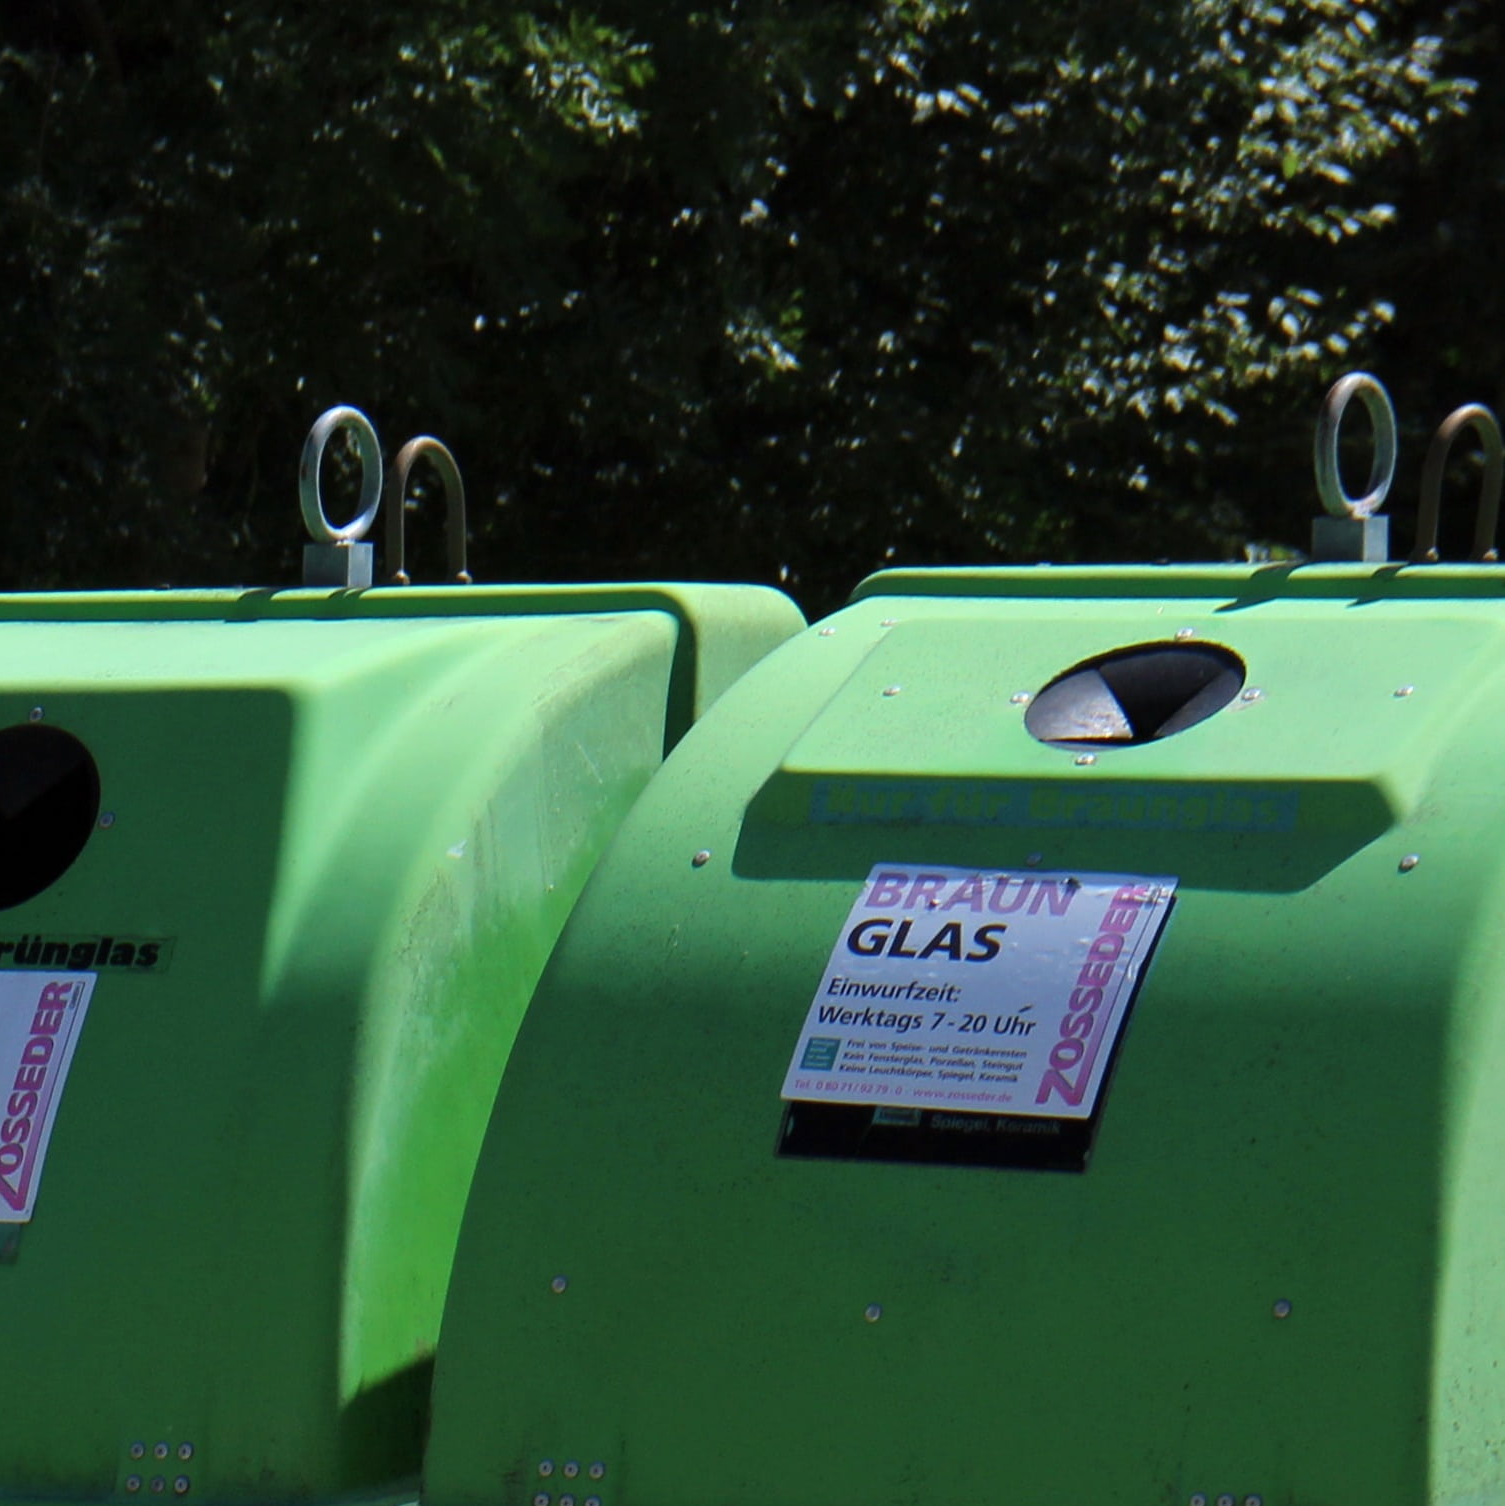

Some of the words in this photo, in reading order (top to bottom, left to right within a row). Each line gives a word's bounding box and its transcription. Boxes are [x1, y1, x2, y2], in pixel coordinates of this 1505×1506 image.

[1029, 786, 1282, 827] Braunglas
[864, 872, 1077, 916] BRAUN
[847, 918, 1007, 962] GLAS
[827, 977, 961, 1002] Einwurfzeit:
[1035, 884, 1150, 1106] ZOSSEDER
[818, 1005, 922, 1032] Werktags
[931, 1012, 946, 1030] 7
[957, 1014, 986, 1033] 20
[994, 1016, 1036, 1036] Uhr
